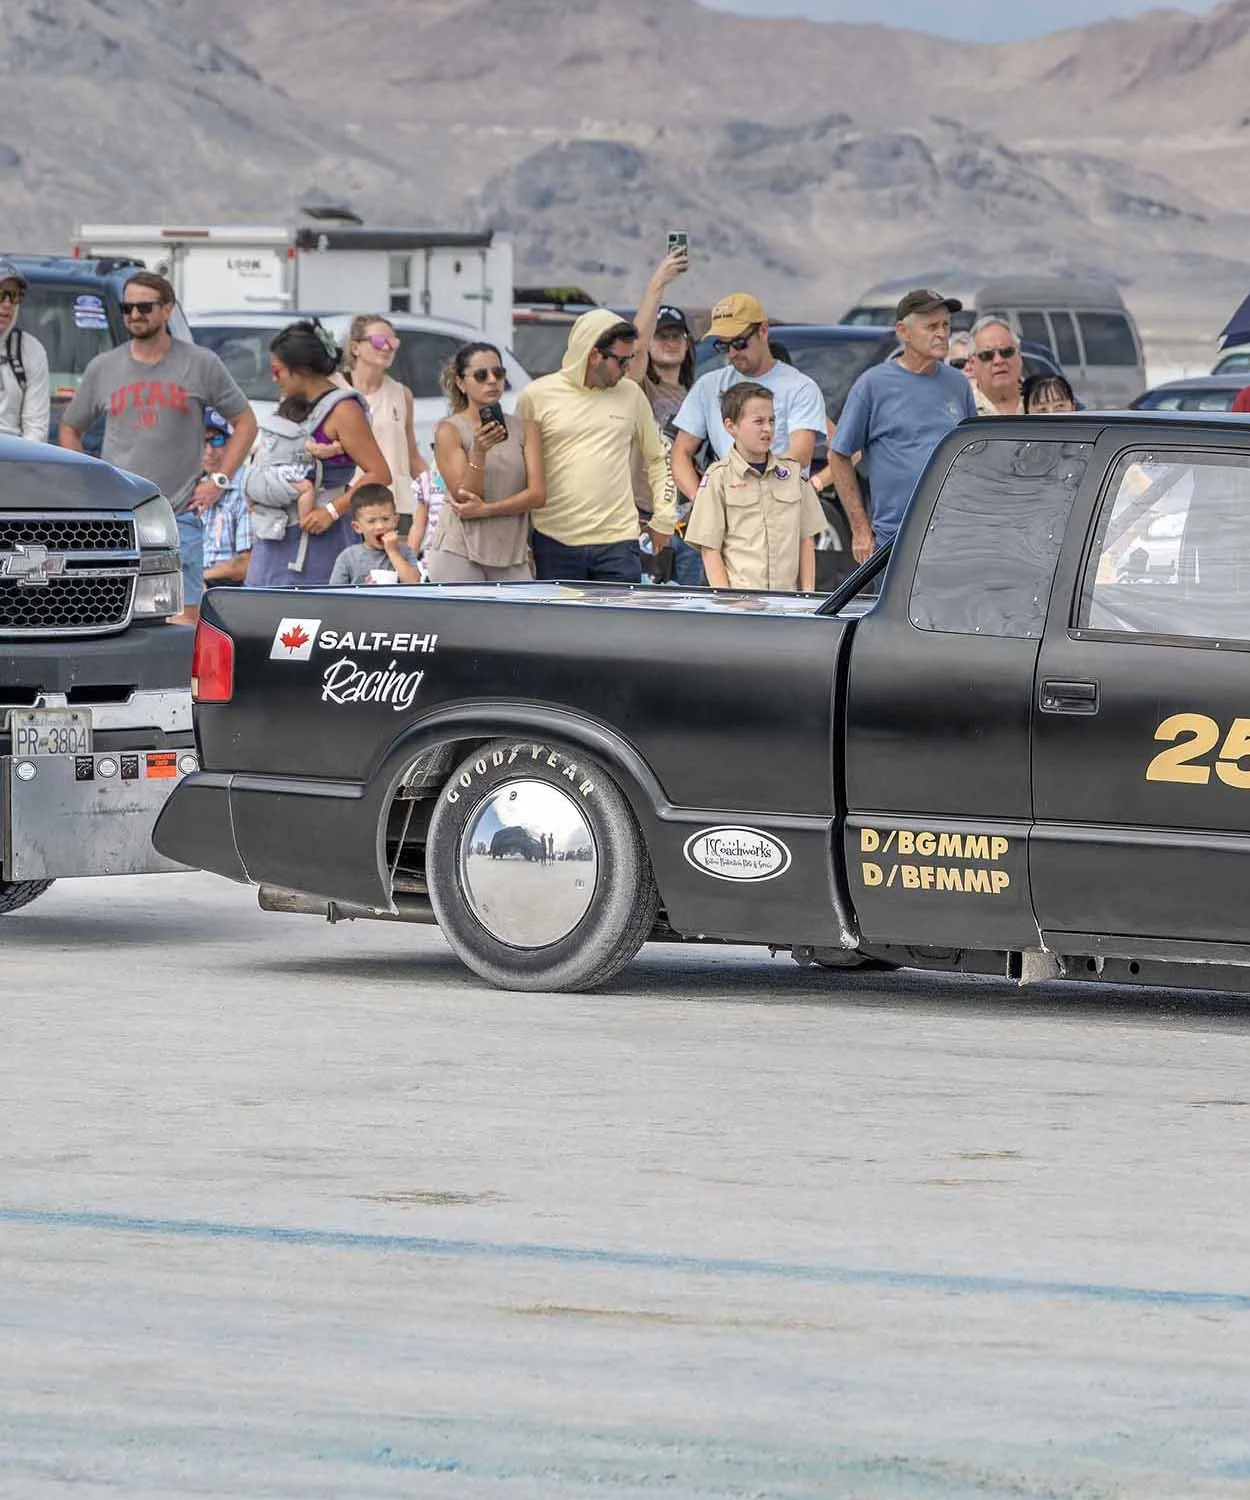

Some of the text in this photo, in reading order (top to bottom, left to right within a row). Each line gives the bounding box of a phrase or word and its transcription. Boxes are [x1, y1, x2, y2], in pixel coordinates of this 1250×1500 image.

[110, 381, 189, 417] UTAH
[319, 630, 438, 653] SALT-EH!
[321, 656, 424, 711] Racing
[447, 744, 594, 803] GOODYEAR
[861, 828, 1009, 861] D/BGMMP
[862, 862, 1010, 894] D/BFMMP
